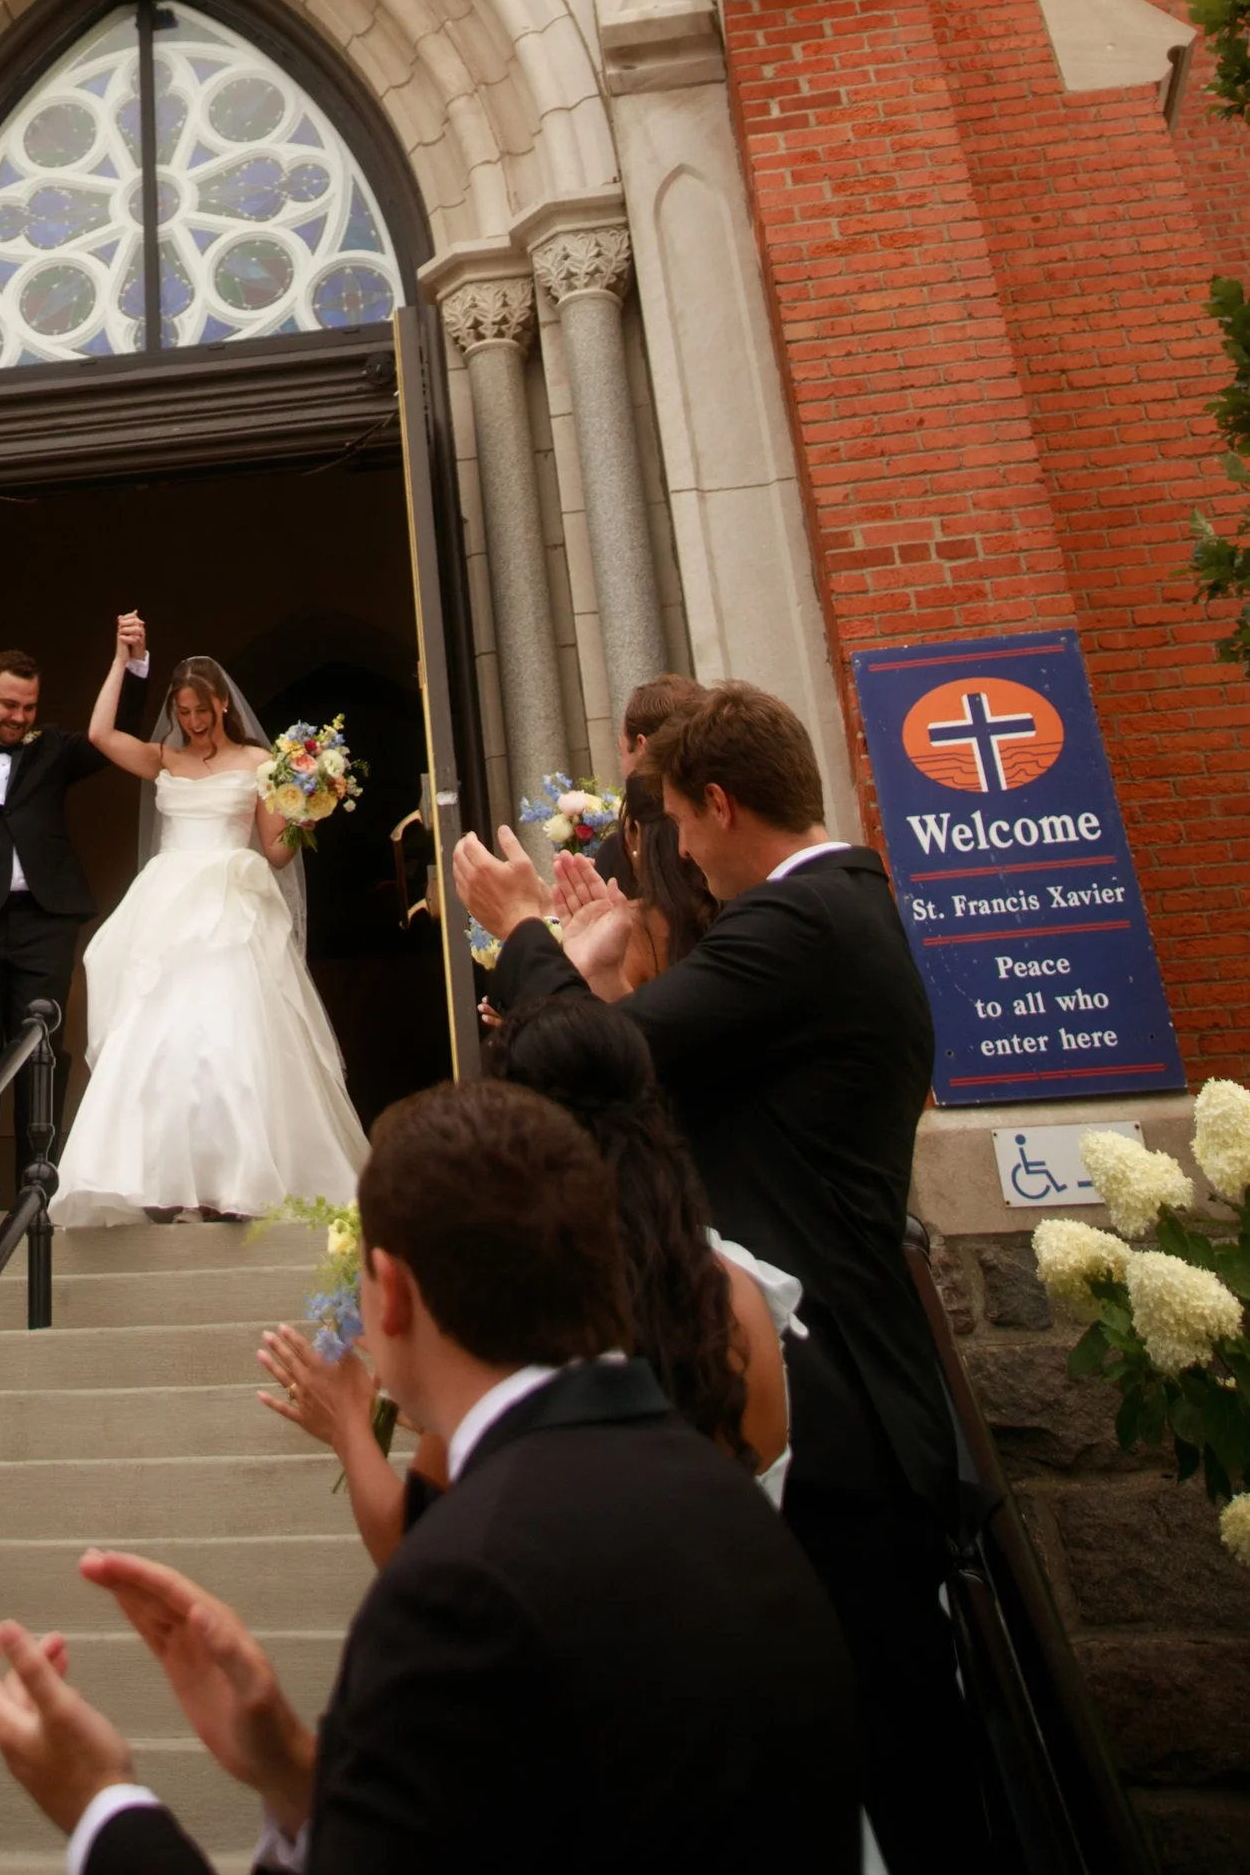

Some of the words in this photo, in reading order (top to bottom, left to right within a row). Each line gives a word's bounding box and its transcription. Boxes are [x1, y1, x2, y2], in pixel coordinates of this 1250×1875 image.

[906, 810, 1102, 855] Welcome
[912, 898, 945, 921] St.
[952, 890, 1041, 917] Francis
[1047, 883, 1126, 909] Xavier
[995, 957, 1071, 980] Peace
[974, 999, 1002, 1019] to
[1013, 991, 1046, 1016] all
[1055, 988, 1109, 1011] who
[980, 1034, 1049, 1057] enter
[1058, 1027, 1119, 1050] here
